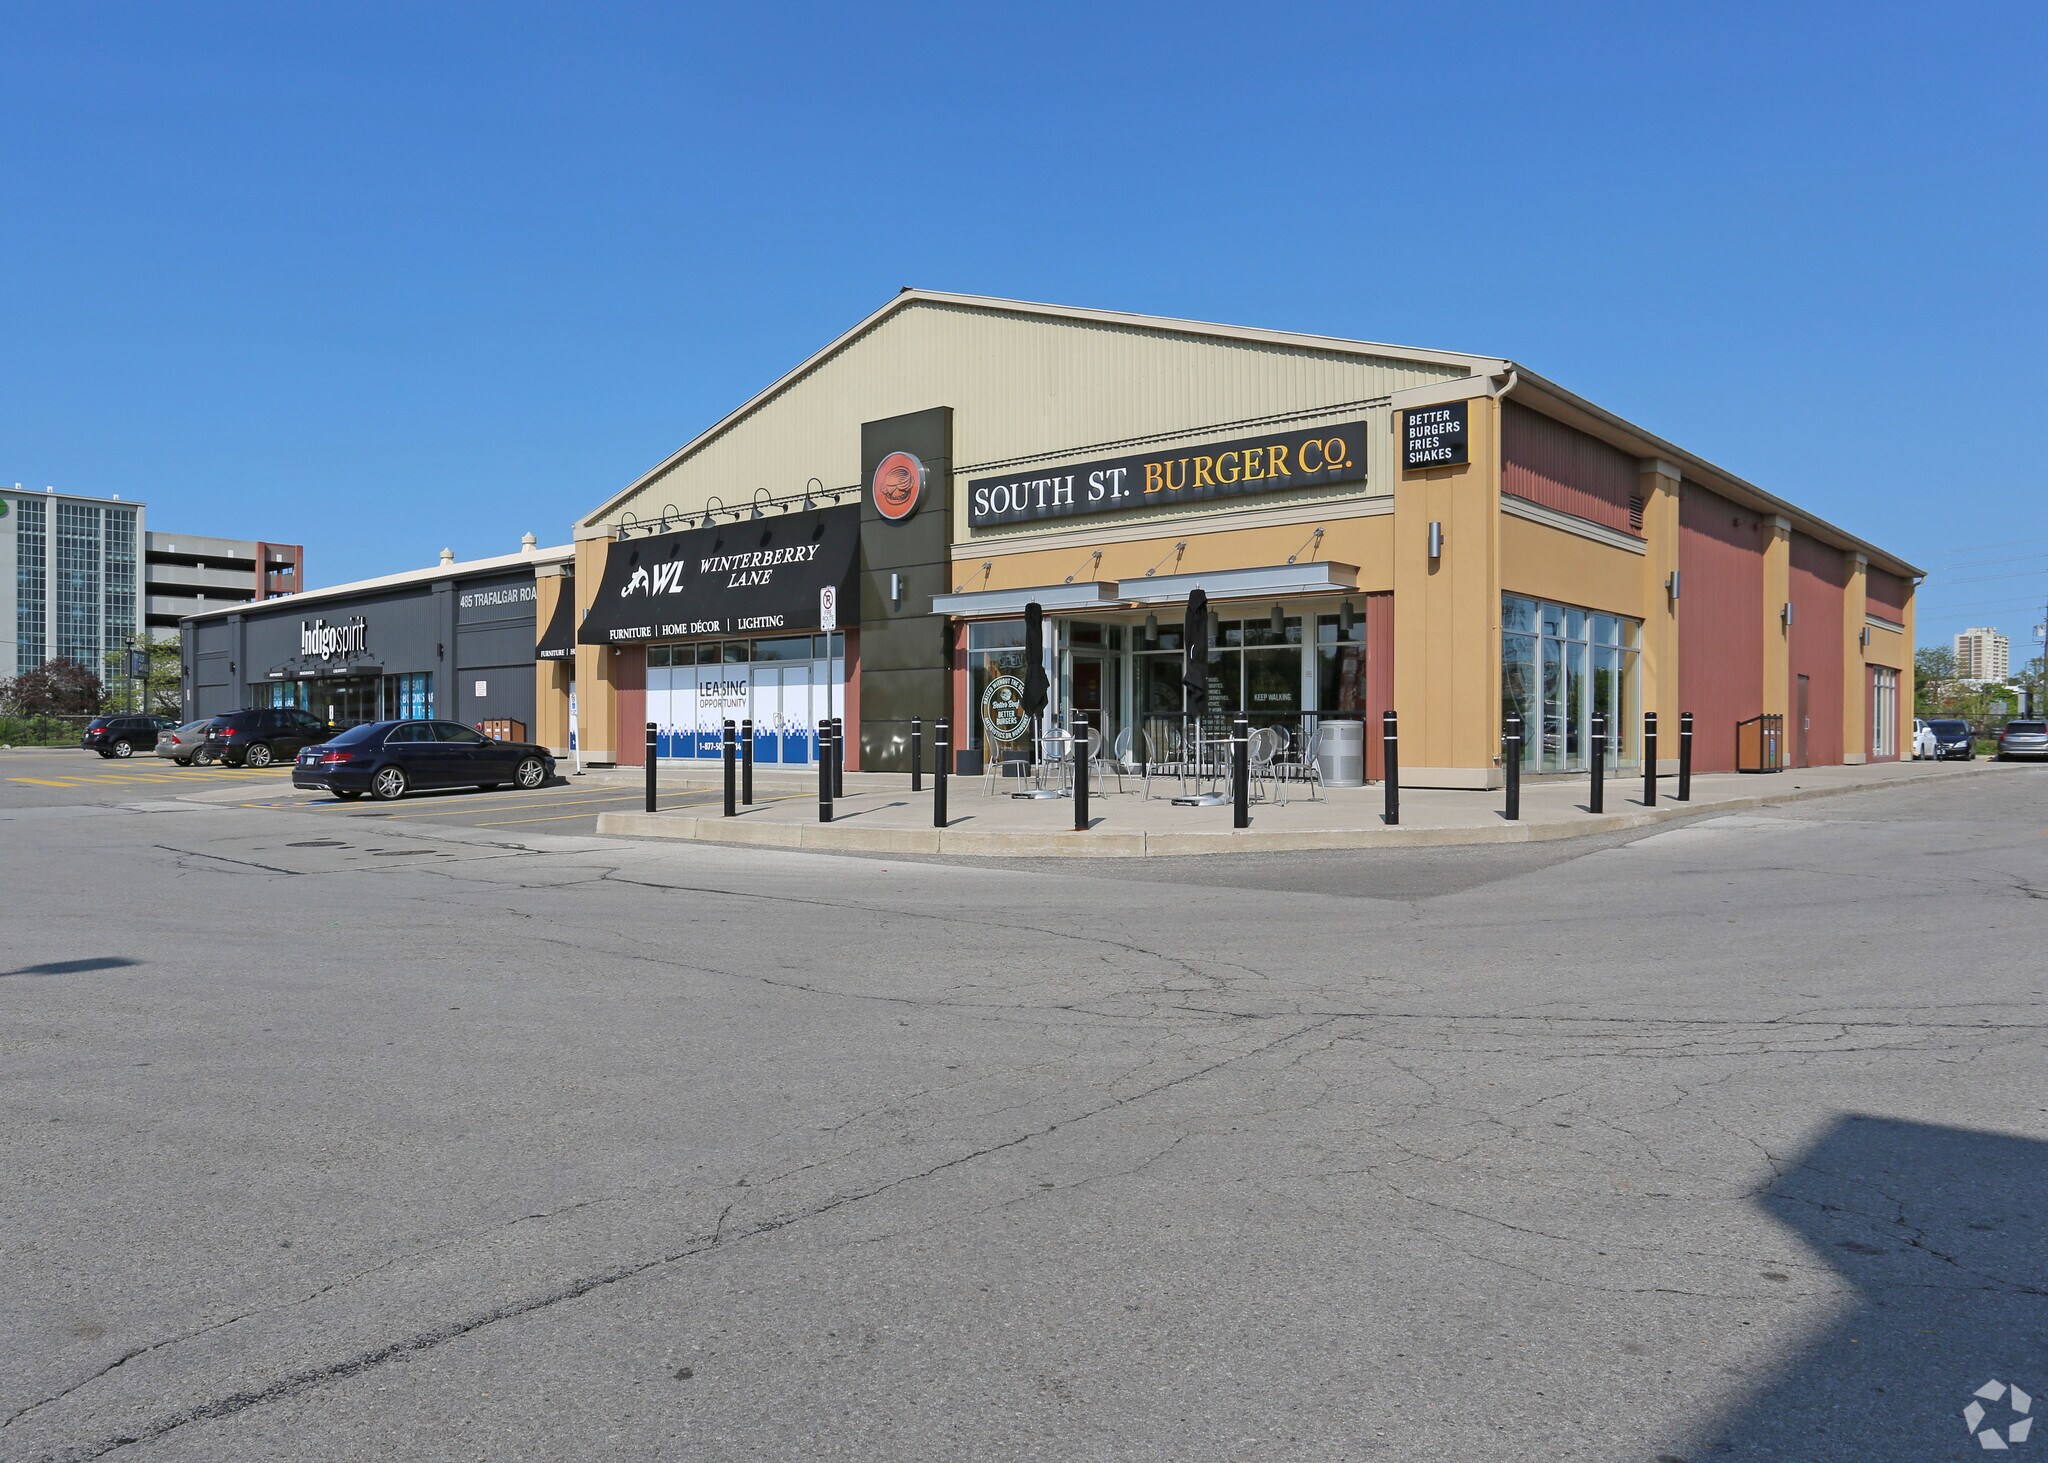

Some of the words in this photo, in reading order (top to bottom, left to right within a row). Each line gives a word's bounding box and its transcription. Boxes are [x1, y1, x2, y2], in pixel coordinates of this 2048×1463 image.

[1409, 410, 1450, 426] BETTER
[1409, 421, 1460, 439] BURGERS
[1409, 436, 1440, 451] FRIES
[1409, 447, 1452, 464] SHAKES
[974, 474, 1075, 517] SOUTH
[1087, 467, 1131, 501] ST.
[1143, 445, 1292, 495] BURGER
[700, 544, 821, 574] WINTERBERRY
[727, 569, 773, 589] LANE
[460, 595, 473, 608] 485
[474, 589, 518, 607] TRAFALGAR
[520, 586, 537, 602] ROA
[609, 626, 652, 640] FURNITURE
[662, 623, 688, 635] HOME
[690, 619, 720, 634] DÉCOR
[738, 614, 784, 630] LIGHTING
[540, 648, 565, 658] FURNITURE
[699, 680, 747, 697] LEASING
[699, 698, 747, 709] OPPORTUNITY
[1254, 693, 1268, 702] KEEP
[996, 717, 1018, 726] BURGERS
[997, 710, 1015, 718] BETTER
